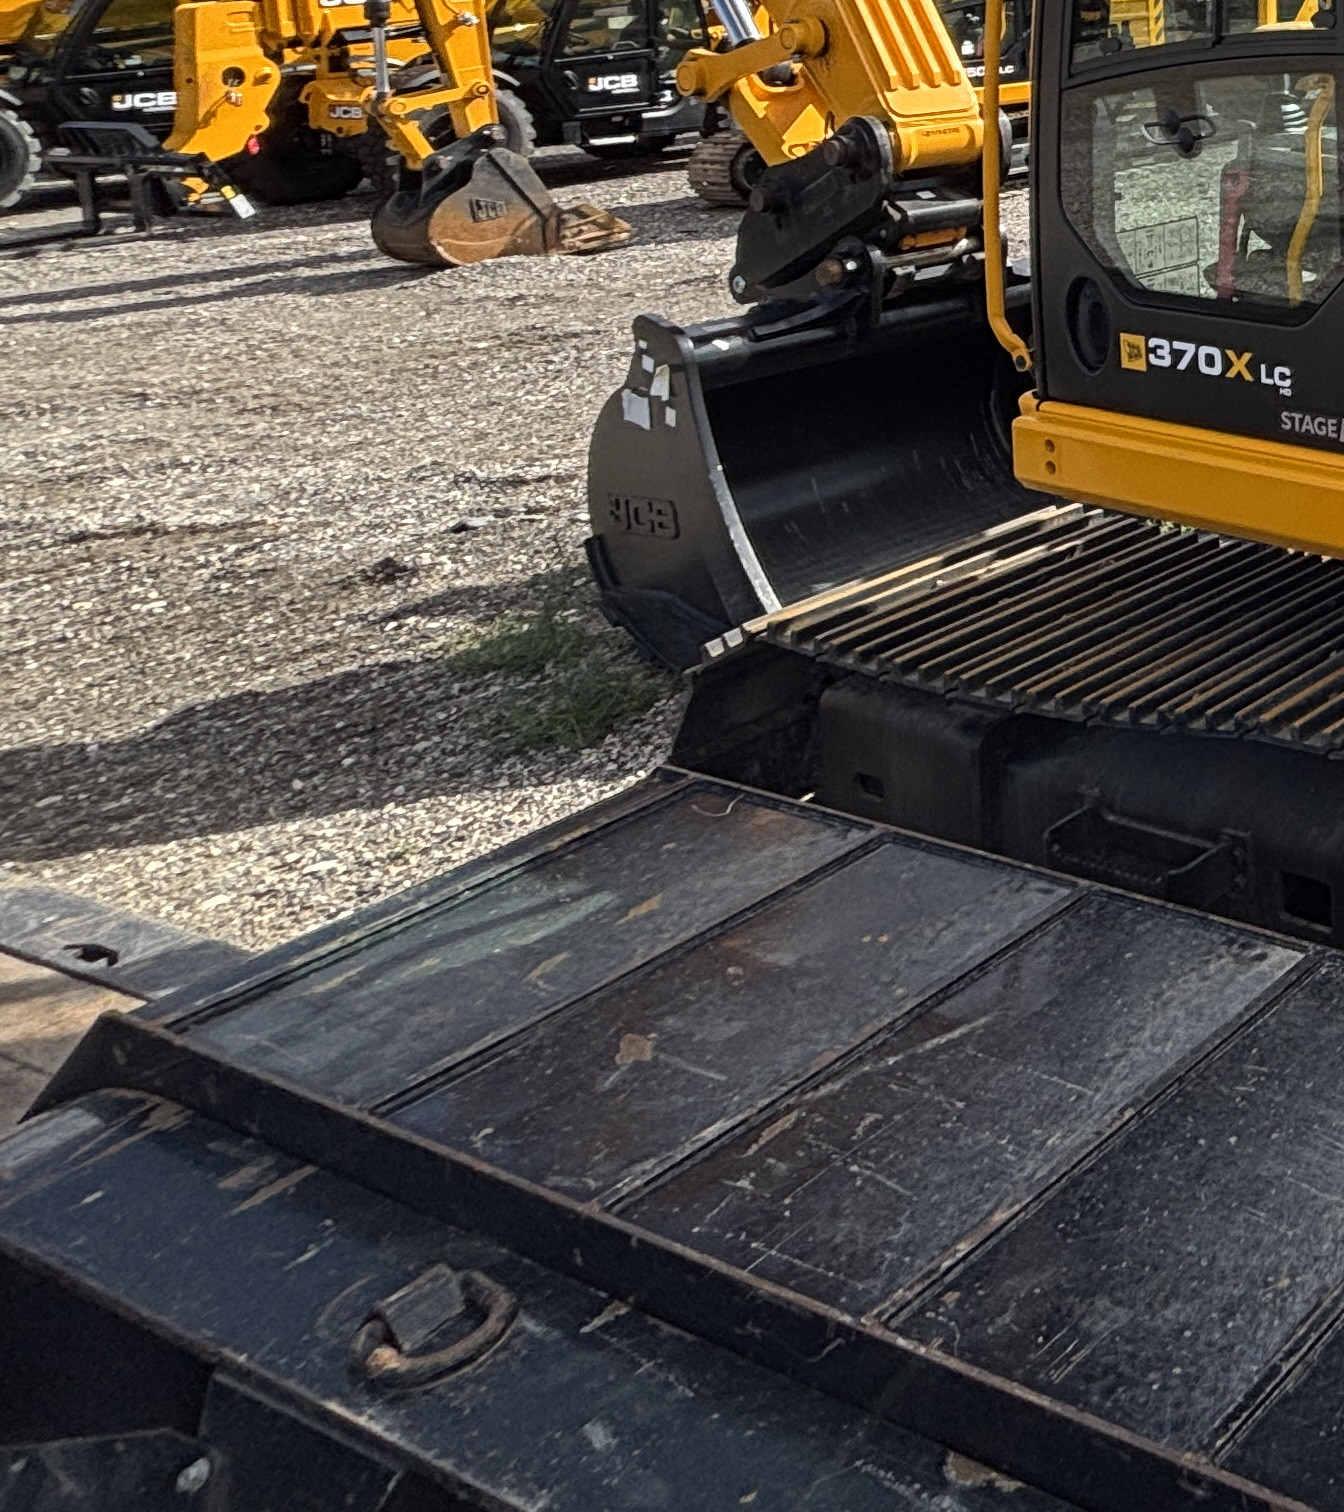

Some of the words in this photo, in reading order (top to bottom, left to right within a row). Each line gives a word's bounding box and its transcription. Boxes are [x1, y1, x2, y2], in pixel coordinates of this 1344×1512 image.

[588, 74, 638, 92] JCB
[330, 106, 363, 119] JCB
[1148, 337, 1254, 382] 370X
[1260, 364, 1292, 387] LC
[1280, 411, 1338, 438] STAGE
[608, 495, 679, 539] JCB
